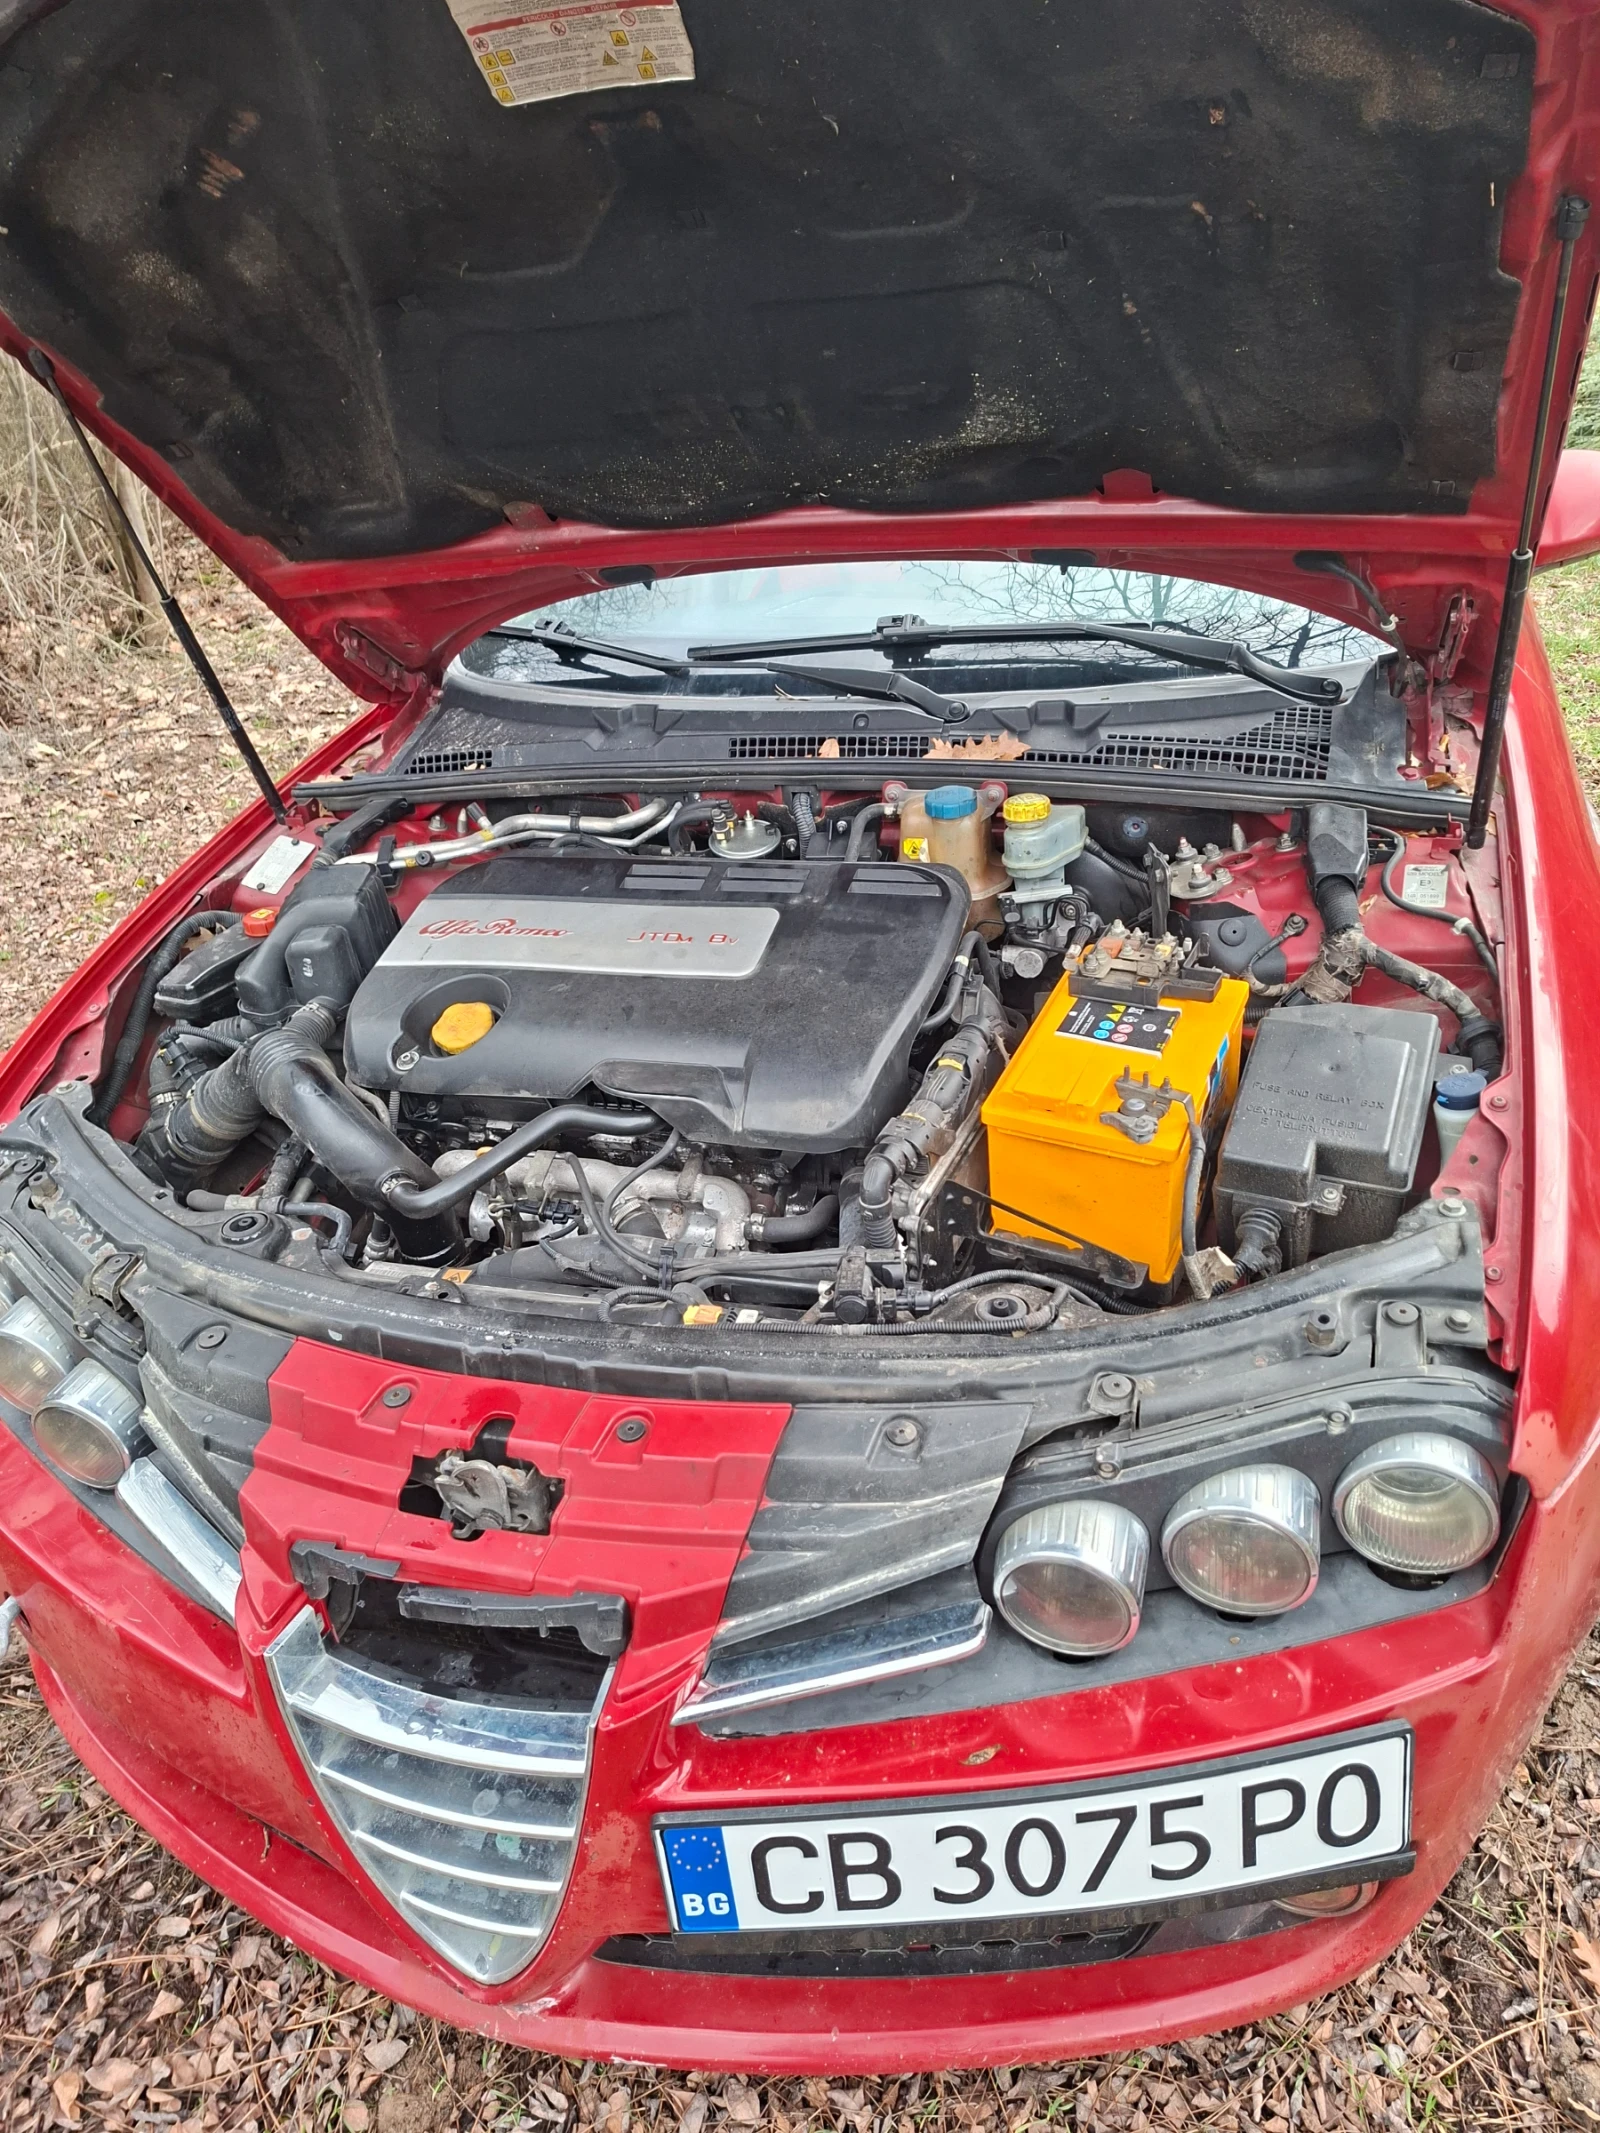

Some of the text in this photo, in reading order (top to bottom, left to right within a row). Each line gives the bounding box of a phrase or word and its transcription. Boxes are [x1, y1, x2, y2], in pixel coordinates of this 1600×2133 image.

[522, 3, 617, 23] PERICOLO DANGER GEFAHR
[419, 918, 570, 939] Alfa Romeo
[1252, 1081, 1281, 1093] FUSE
[1287, 1089, 1309, 1098] AND
[1315, 1092, 1353, 1104] RELAY
[1246, 1105, 1368, 1131] CENTRALINA FUSIBILI
[749, 1762, 1382, 1915] CB 3075 PO
[684, 1893, 731, 1917] BG
